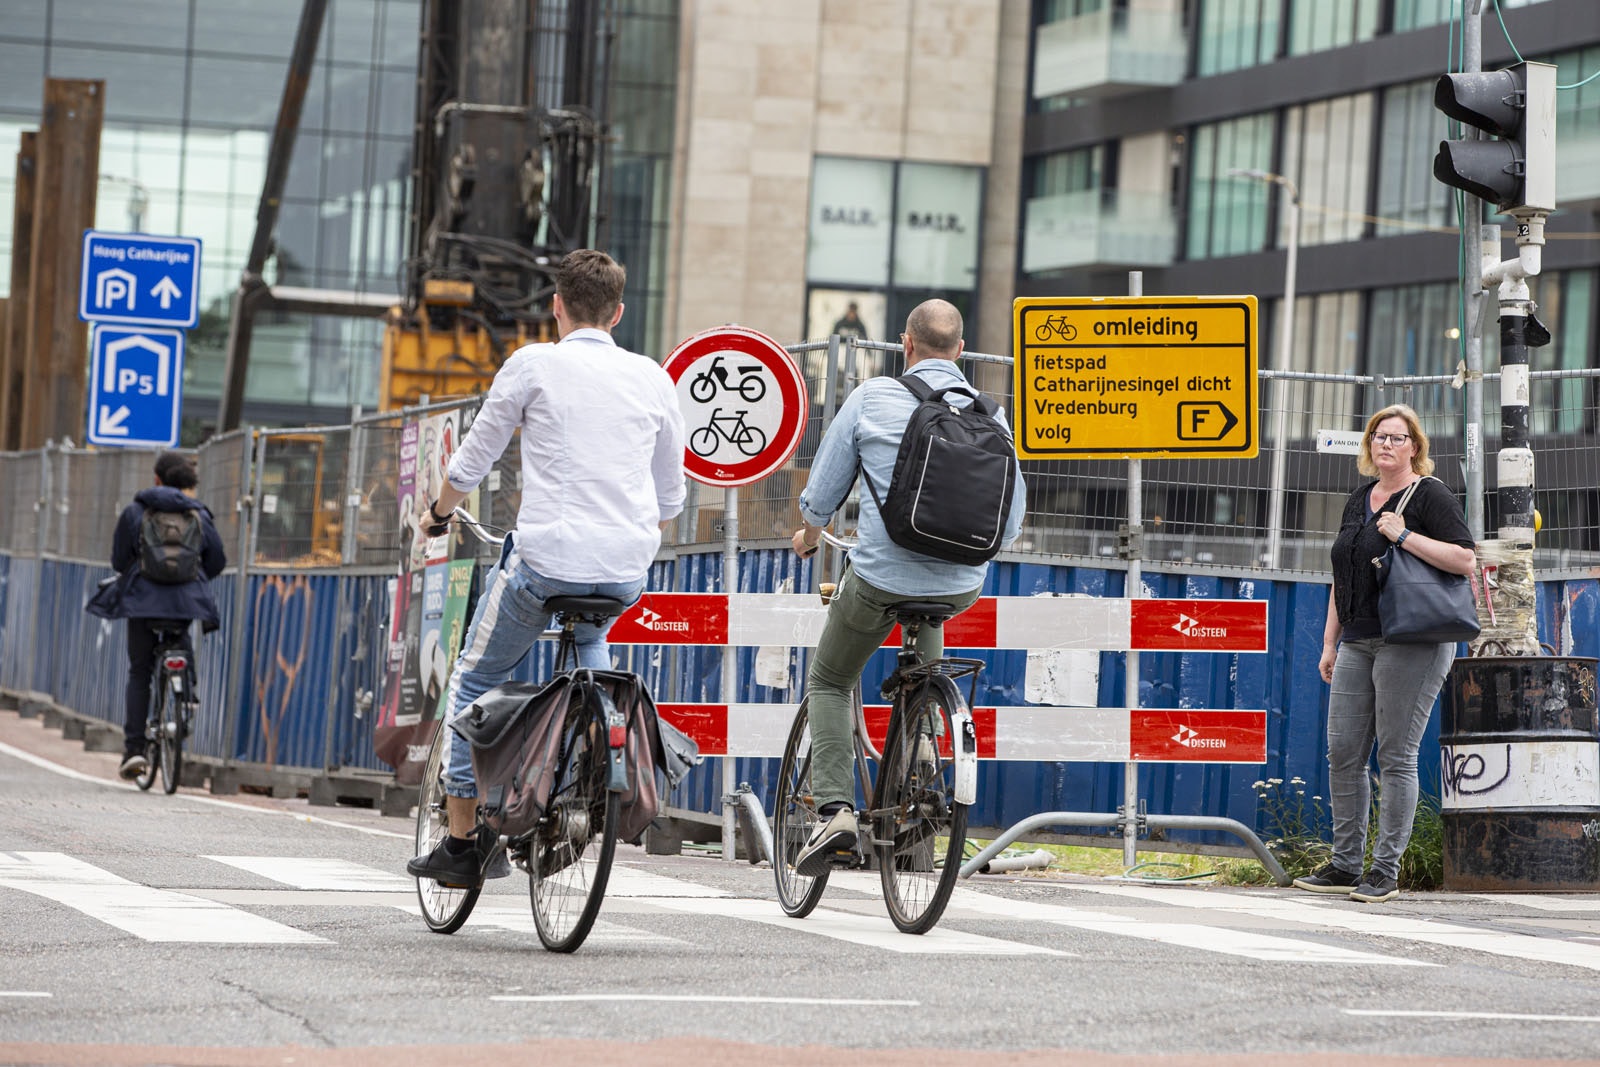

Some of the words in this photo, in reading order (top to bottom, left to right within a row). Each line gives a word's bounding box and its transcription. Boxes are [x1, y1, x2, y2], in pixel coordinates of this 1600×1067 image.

[93, 245, 126, 261] Hoog
[127, 246, 190, 266] Catharijne
[1093, 316, 1199, 342] omleiding
[1033, 354, 1107, 374] fietspad
[1033, 375, 1179, 397] Catharijnesingel
[1186, 375, 1232, 392] dicht
[1034, 398, 1138, 420] Vredenburg
[1192, 409, 1210, 433] F
[1034, 423, 1072, 444] volg
